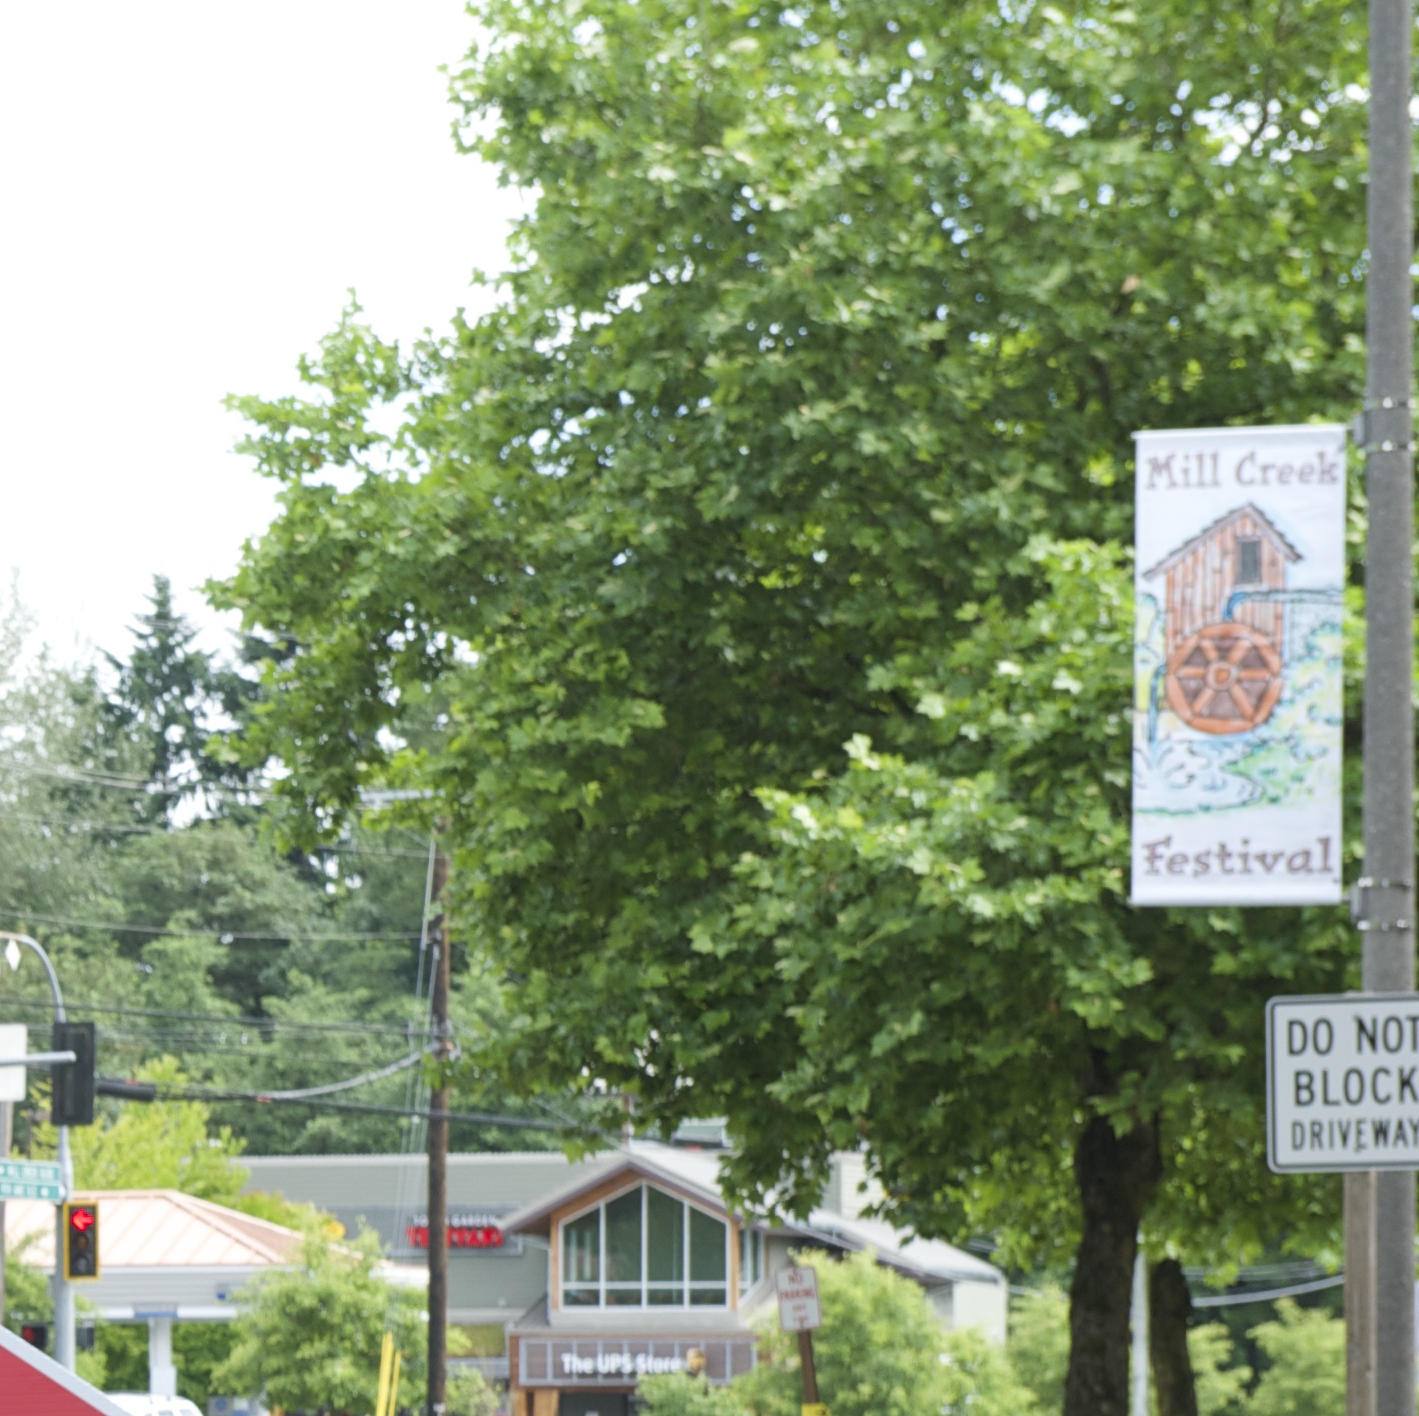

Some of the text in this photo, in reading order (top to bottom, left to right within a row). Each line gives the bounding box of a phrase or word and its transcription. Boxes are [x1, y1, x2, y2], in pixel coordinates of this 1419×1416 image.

[1144, 449, 1339, 491] Mill Creek
[1142, 833, 1335, 877] Festival
[1287, 1014, 1419, 1057] DO NOT
[1294, 1066, 1419, 1107] BLOCK
[1291, 1117, 1419, 1153] DRIVEWAY
[561, 1351, 683, 1375] The UPS Store
